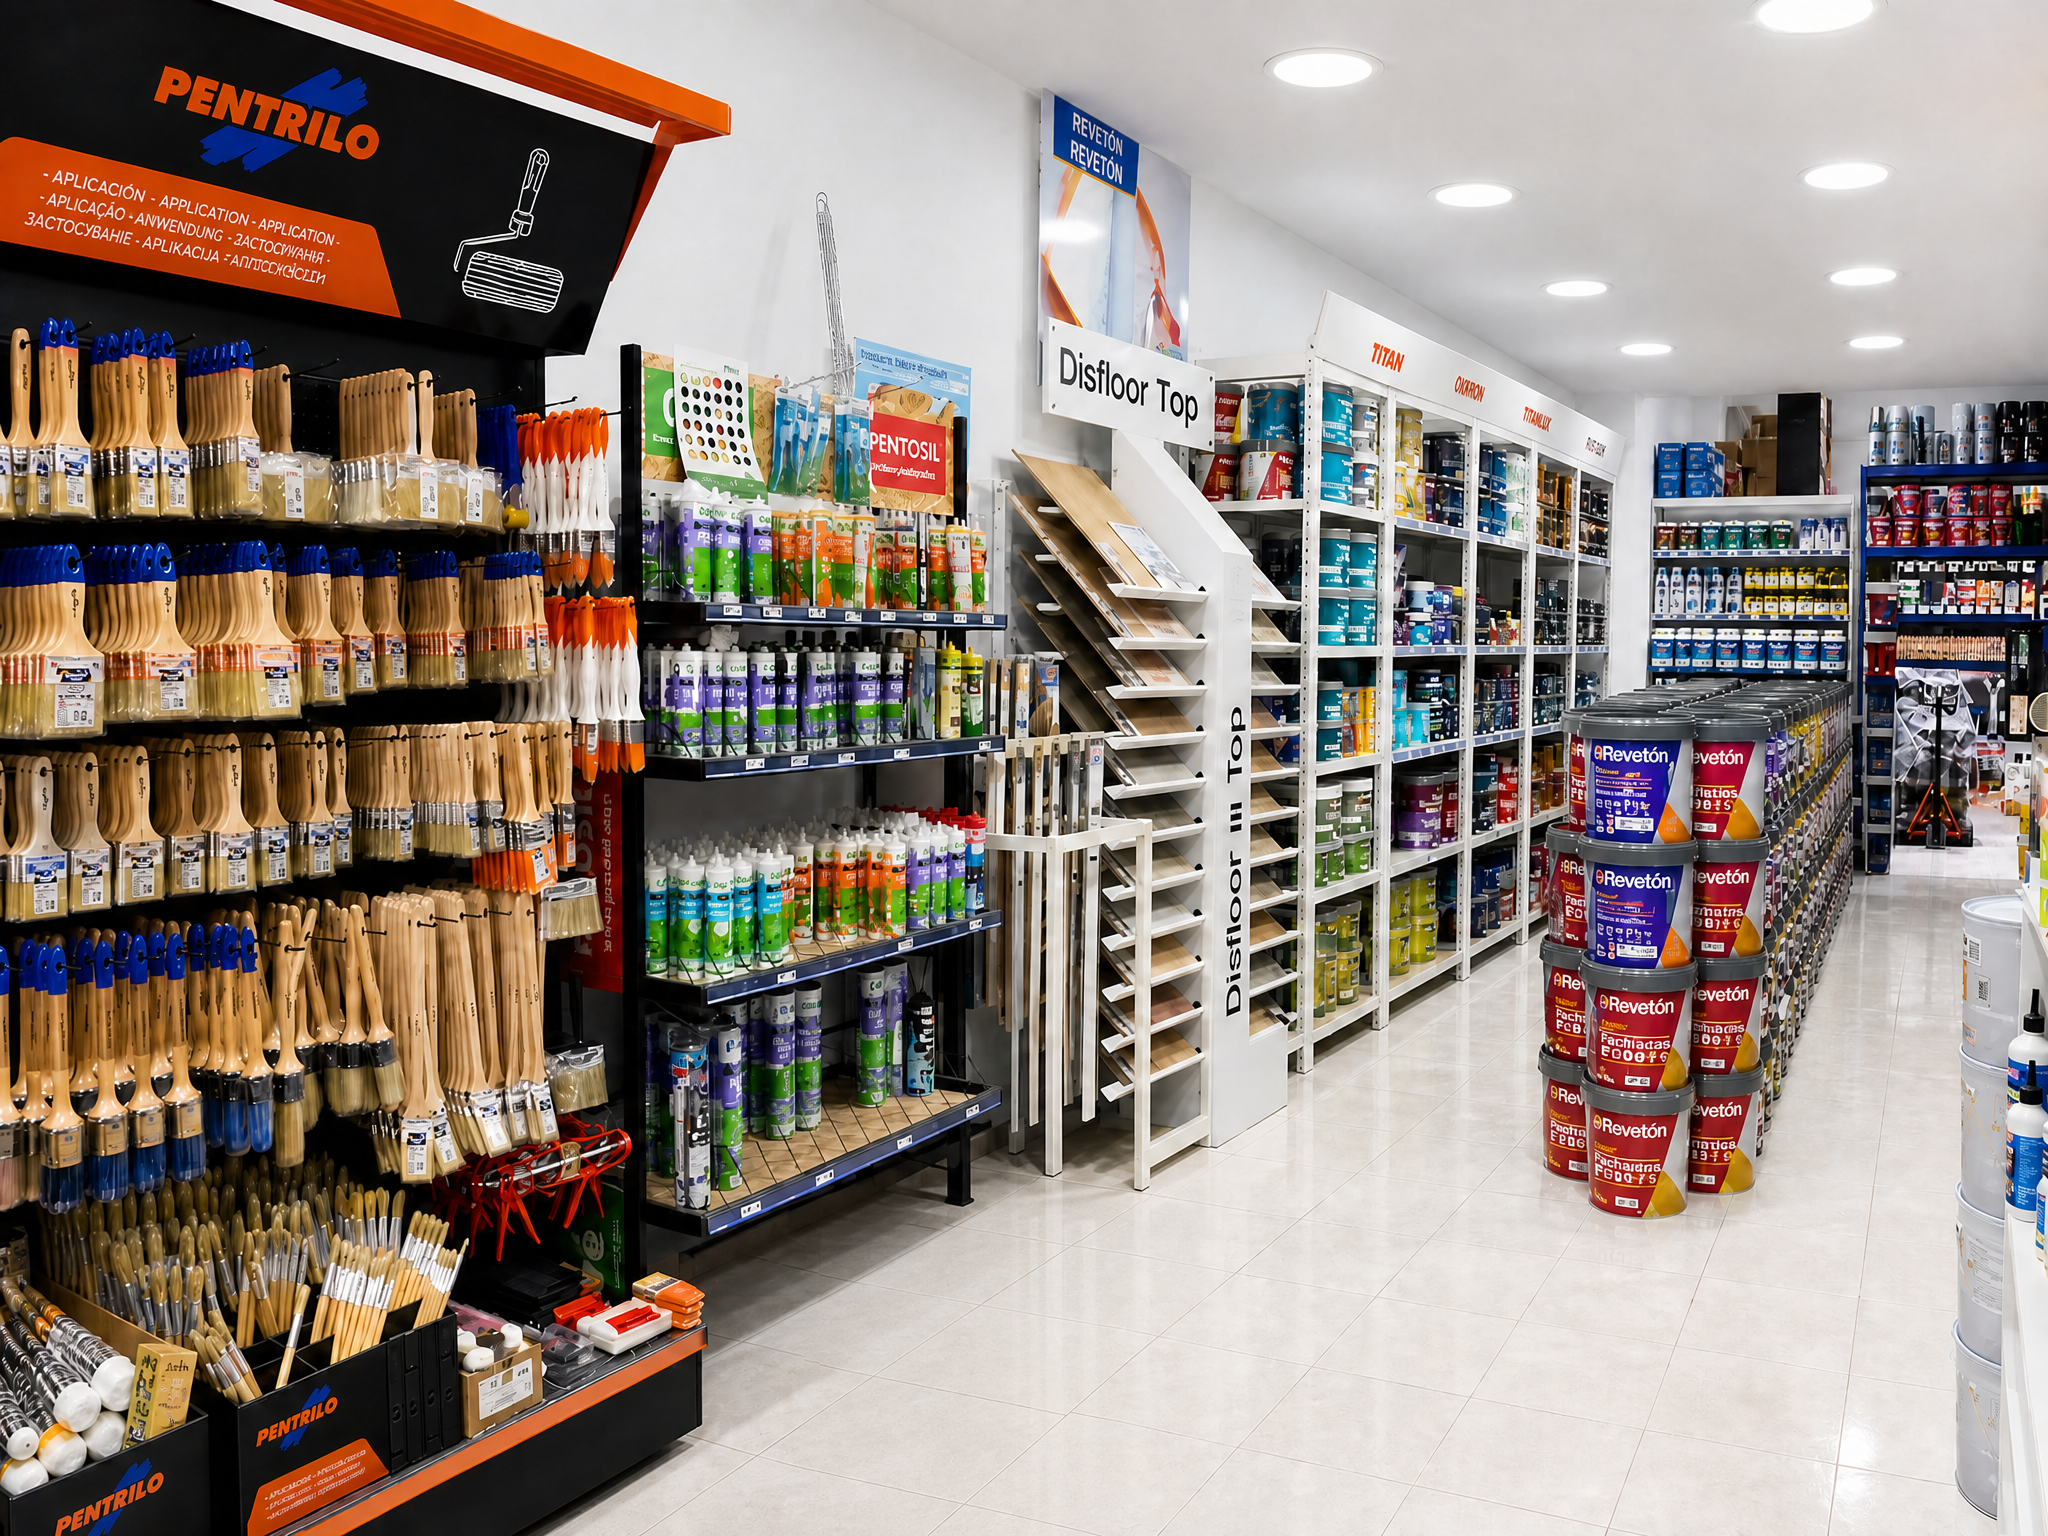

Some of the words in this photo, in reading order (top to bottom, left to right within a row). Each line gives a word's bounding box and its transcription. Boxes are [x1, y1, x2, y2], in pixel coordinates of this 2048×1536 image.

[154, 66, 380, 160] PENTRILO
[1072, 112, 1123, 157] REVETÓN
[1070, 139, 1123, 185] REVETÓN
[52, 170, 147, 203] APLICACIÓN
[159, 195, 250, 226] APPLICATION
[258, 218, 335, 247] APPLICATION
[134, 212, 224, 242] ANWENDUNG
[142, 236, 220, 264] APLIKACIJA
[1371, 342, 1405, 373] TITAN
[1059, 346, 1149, 407] Disfloor
[1156, 378, 1199, 429] Top
[870, 431, 941, 463] PENTOSIL
[1227, 706, 1246, 784] Top
[1602, 745, 1669, 764] Revetón
[1693, 749, 1744, 765] evetón
[1604, 870, 1671, 889] Revetón
[1226, 850, 1242, 1018] Disfloor
[1609, 995, 1674, 1015] Revetón
[1692, 1101, 1742, 1118] evetón
[1602, 1117, 1667, 1139] Revetón
[256, 1396, 339, 1449] PENTRILO
[55, 1472, 165, 1536] PENTRILO
